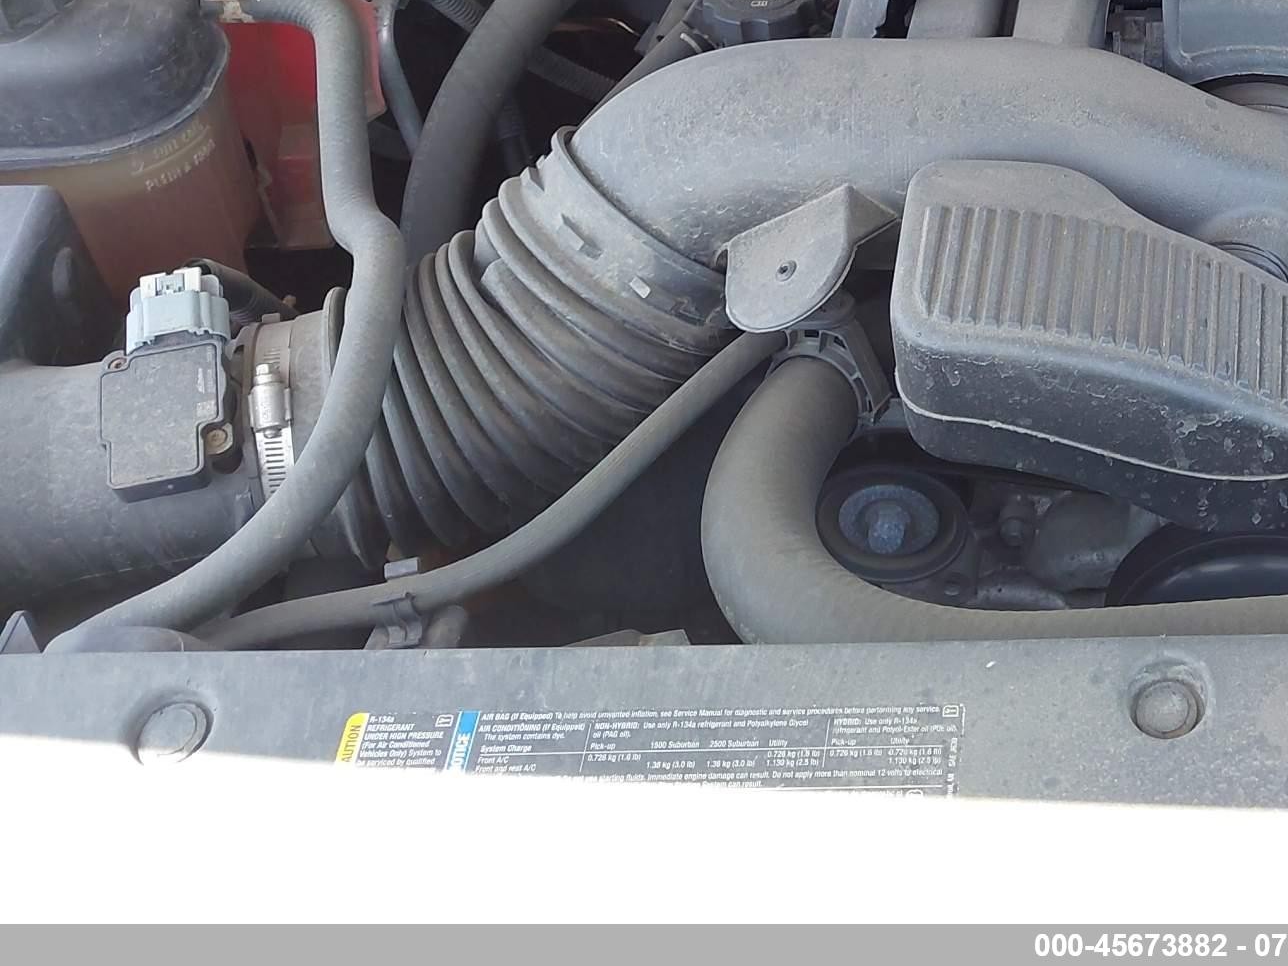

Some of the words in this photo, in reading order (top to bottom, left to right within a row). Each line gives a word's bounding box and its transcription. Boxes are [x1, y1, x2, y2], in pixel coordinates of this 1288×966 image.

[563, 712, 578, 720] help
[735, 709, 768, 717] diagnostic
[807, 707, 842, 716] procedures
[698, 720, 732, 729] refrigerant
[747, 719, 787, 728] Polyalkylene
[788, 719, 809, 727] Glycol
[879, 717, 894, 726] only
[366, 724, 415, 732] REFRIGERANT
[479, 724, 490, 732] AIR
[491, 724, 542, 732] CONDITIONING
[364, 732, 388, 740] UNDER
[389, 732, 408, 740] HIGH
[408, 731, 444, 739] PRESSURE
[602, 731, 618, 739] (PAG
[341, 724, 362, 763] AUTION
[377, 741, 388, 749] Air
[590, 742, 616, 750] Pick-up
[669, 740, 701, 748] Suburban
[769, 739, 788, 747] Utility
[831, 738, 857, 746] Pick-up
[450, 733, 471, 770] OTICE
[480, 745, 506, 753] System
[507, 744, 532, 753] Charge
[909, 748, 919, 756] kg
[389, 749, 407, 758] Only)
[408, 749, 433, 757] System
[786, 750, 797, 758] kg
[849, 749, 860, 757] kg
[405, 757, 435, 765] qualified
[477, 756, 495, 764] Front
[496, 755, 510, 763] A/C
[607, 754, 618, 762] kg
[661, 761, 672, 769] kg
[672, 761, 685, 769] (3.0
[721, 760, 732, 768] kg
[732, 760, 746, 768] (3.0
[785, 759, 796, 767] kg
[475, 766, 494, 774] Front
[523, 764, 537, 772] A/C
[647, 773, 683, 781] Immediate
[684, 773, 707, 781] engine
[708, 772, 735, 781] damage
[795, 770, 813, 780] apply
[850, 769, 876, 777] nominal
[878, 769, 887, 777] 12
[912, 768, 943, 776] electrical
[742, 780, 763, 788] result.
